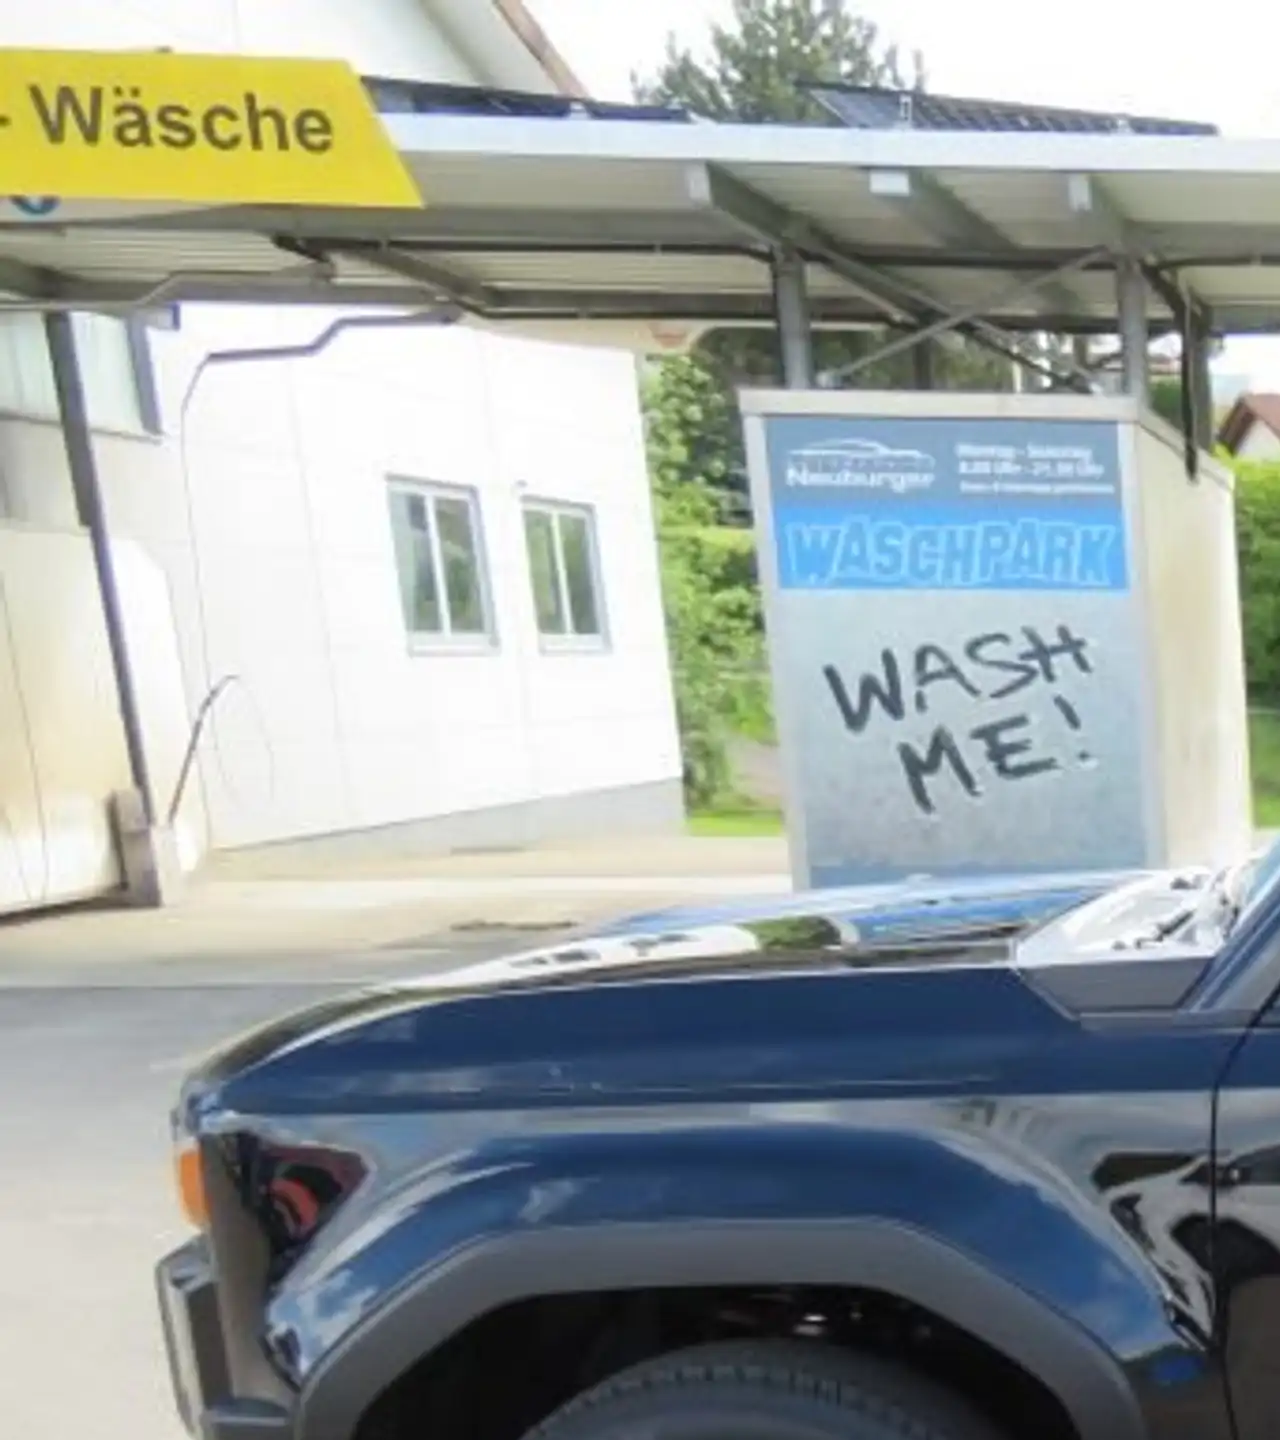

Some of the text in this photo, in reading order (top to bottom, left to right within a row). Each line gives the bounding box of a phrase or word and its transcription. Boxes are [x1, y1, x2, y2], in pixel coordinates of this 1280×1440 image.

[28, 84, 333, 153] Wäsche
[786, 515, 1116, 586] WASCHPARK
[823, 625, 1093, 733] WASH
[897, 694, 1090, 814] ME!
